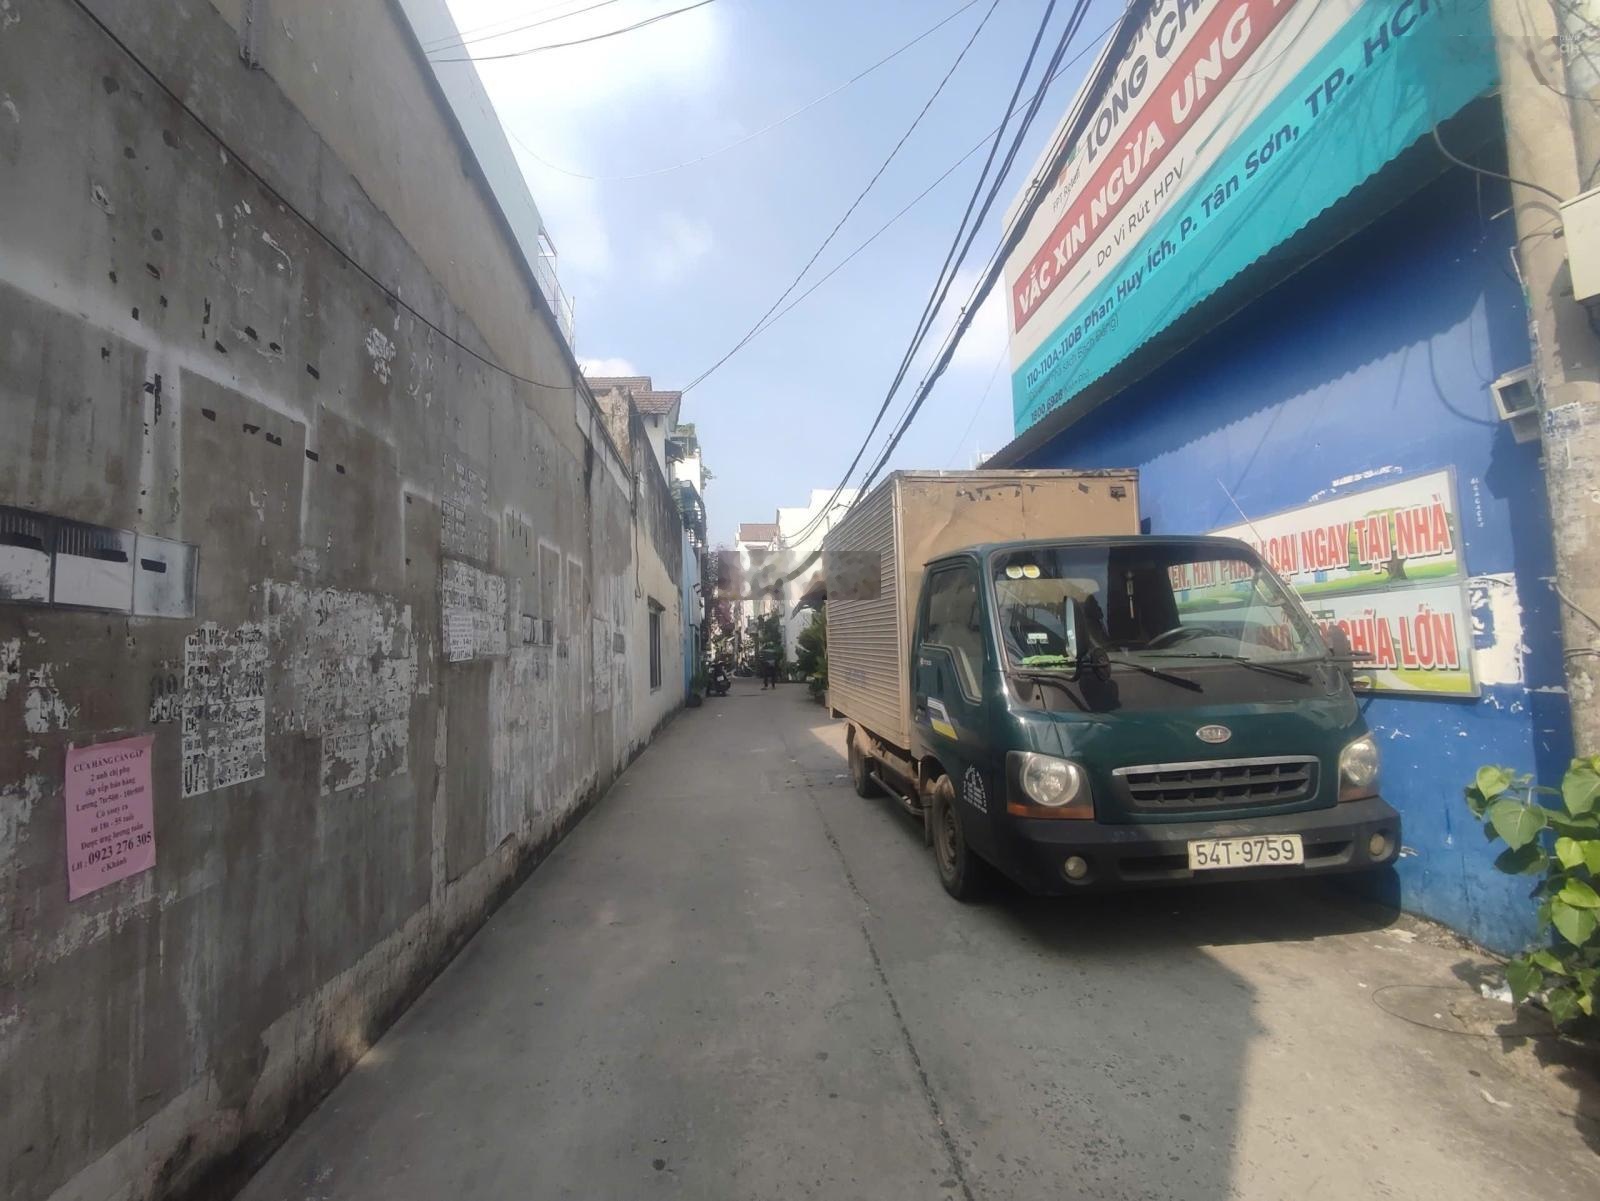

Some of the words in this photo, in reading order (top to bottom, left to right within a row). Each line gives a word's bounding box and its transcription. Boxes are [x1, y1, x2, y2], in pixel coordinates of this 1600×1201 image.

[1018, 261, 1051, 315] VẮC
[1053, 214, 1087, 277] XIN
[1090, 121, 1165, 229] NGỪA
[1171, 2, 1251, 125] UNG
[1086, 54, 1149, 164] LONG
[1084, 296, 1114, 334] Phan
[1116, 266, 1143, 302] Huy
[1181, 216, 1198, 241] P.
[1201, 174, 1239, 218] Tân
[1245, 124, 1299, 180] Sơn,
[1305, 67, 1354, 118] TP.
[1364, 0, 1429, 68] HC
[1097, 245, 1112, 267] Do
[1113, 224, 1125, 246] Vi
[1128, 200, 1151, 234] Rút
[1154, 158, 1184, 204] HPV
[1301, 522, 1349, 569] NGAY
[1355, 513, 1391, 571] TẠI
[1395, 494, 1452, 556] NHÀ
[1399, 603, 1458, 666] LỚN
[88, 845, 113, 865] 0923
[116, 839, 134, 855] 276
[136, 831, 152, 848] 305
